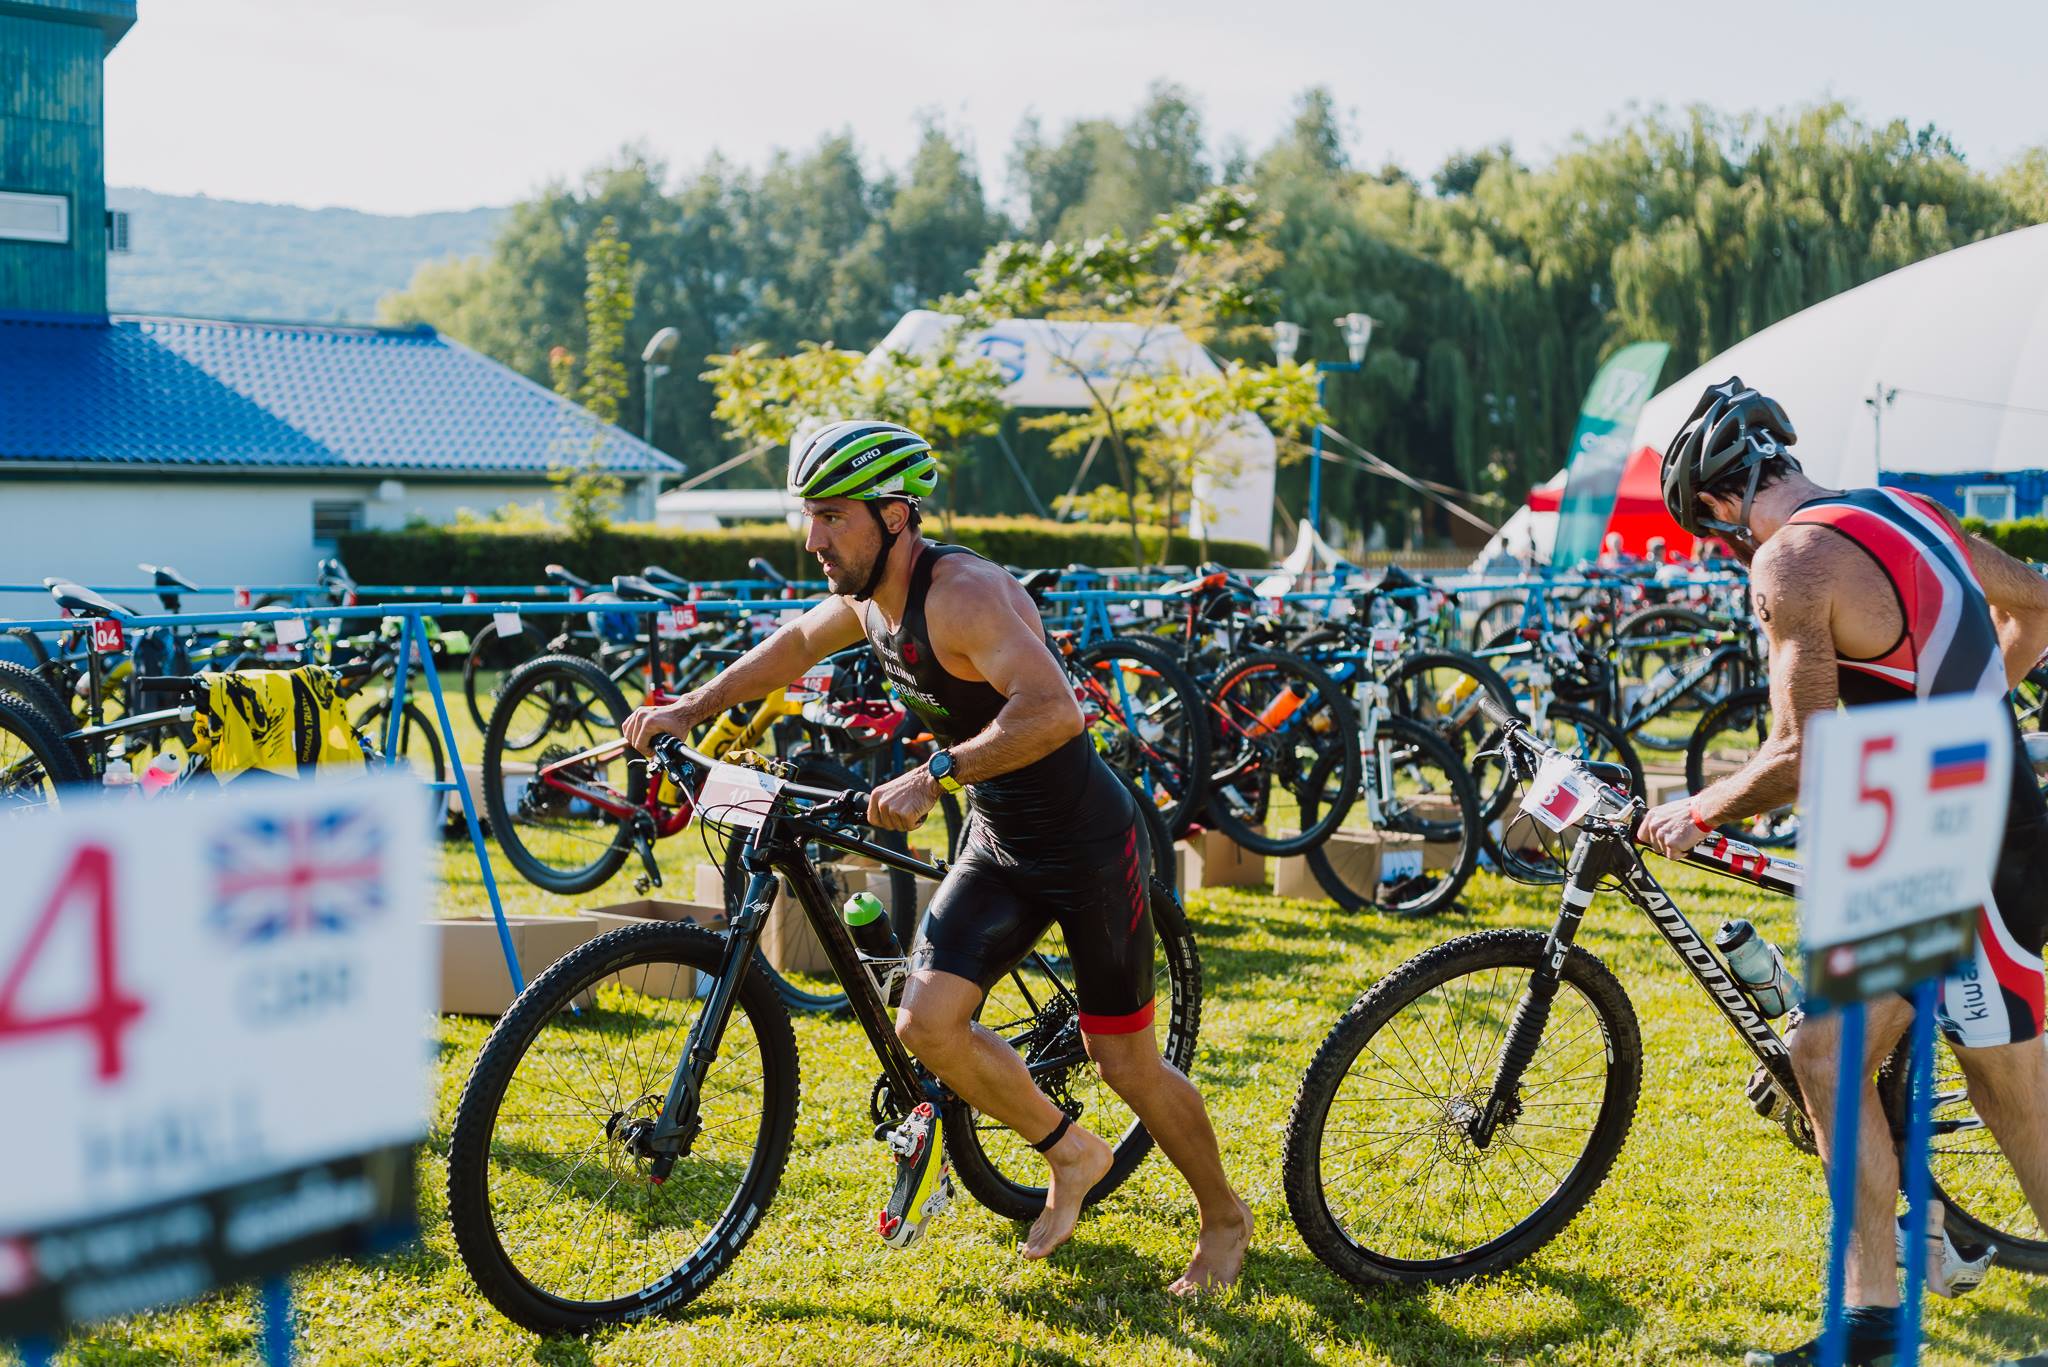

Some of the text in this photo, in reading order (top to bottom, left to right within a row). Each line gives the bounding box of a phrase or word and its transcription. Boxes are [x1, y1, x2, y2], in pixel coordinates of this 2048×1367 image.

[851, 448, 881, 468] GIRO
[887, 676, 940, 706] ERBALIFE
[1846, 735, 1897, 870] 5
[0, 842, 147, 1082] 4
[624, 1287, 684, 1322] RACING
[691, 1247, 724, 1289] RAY
